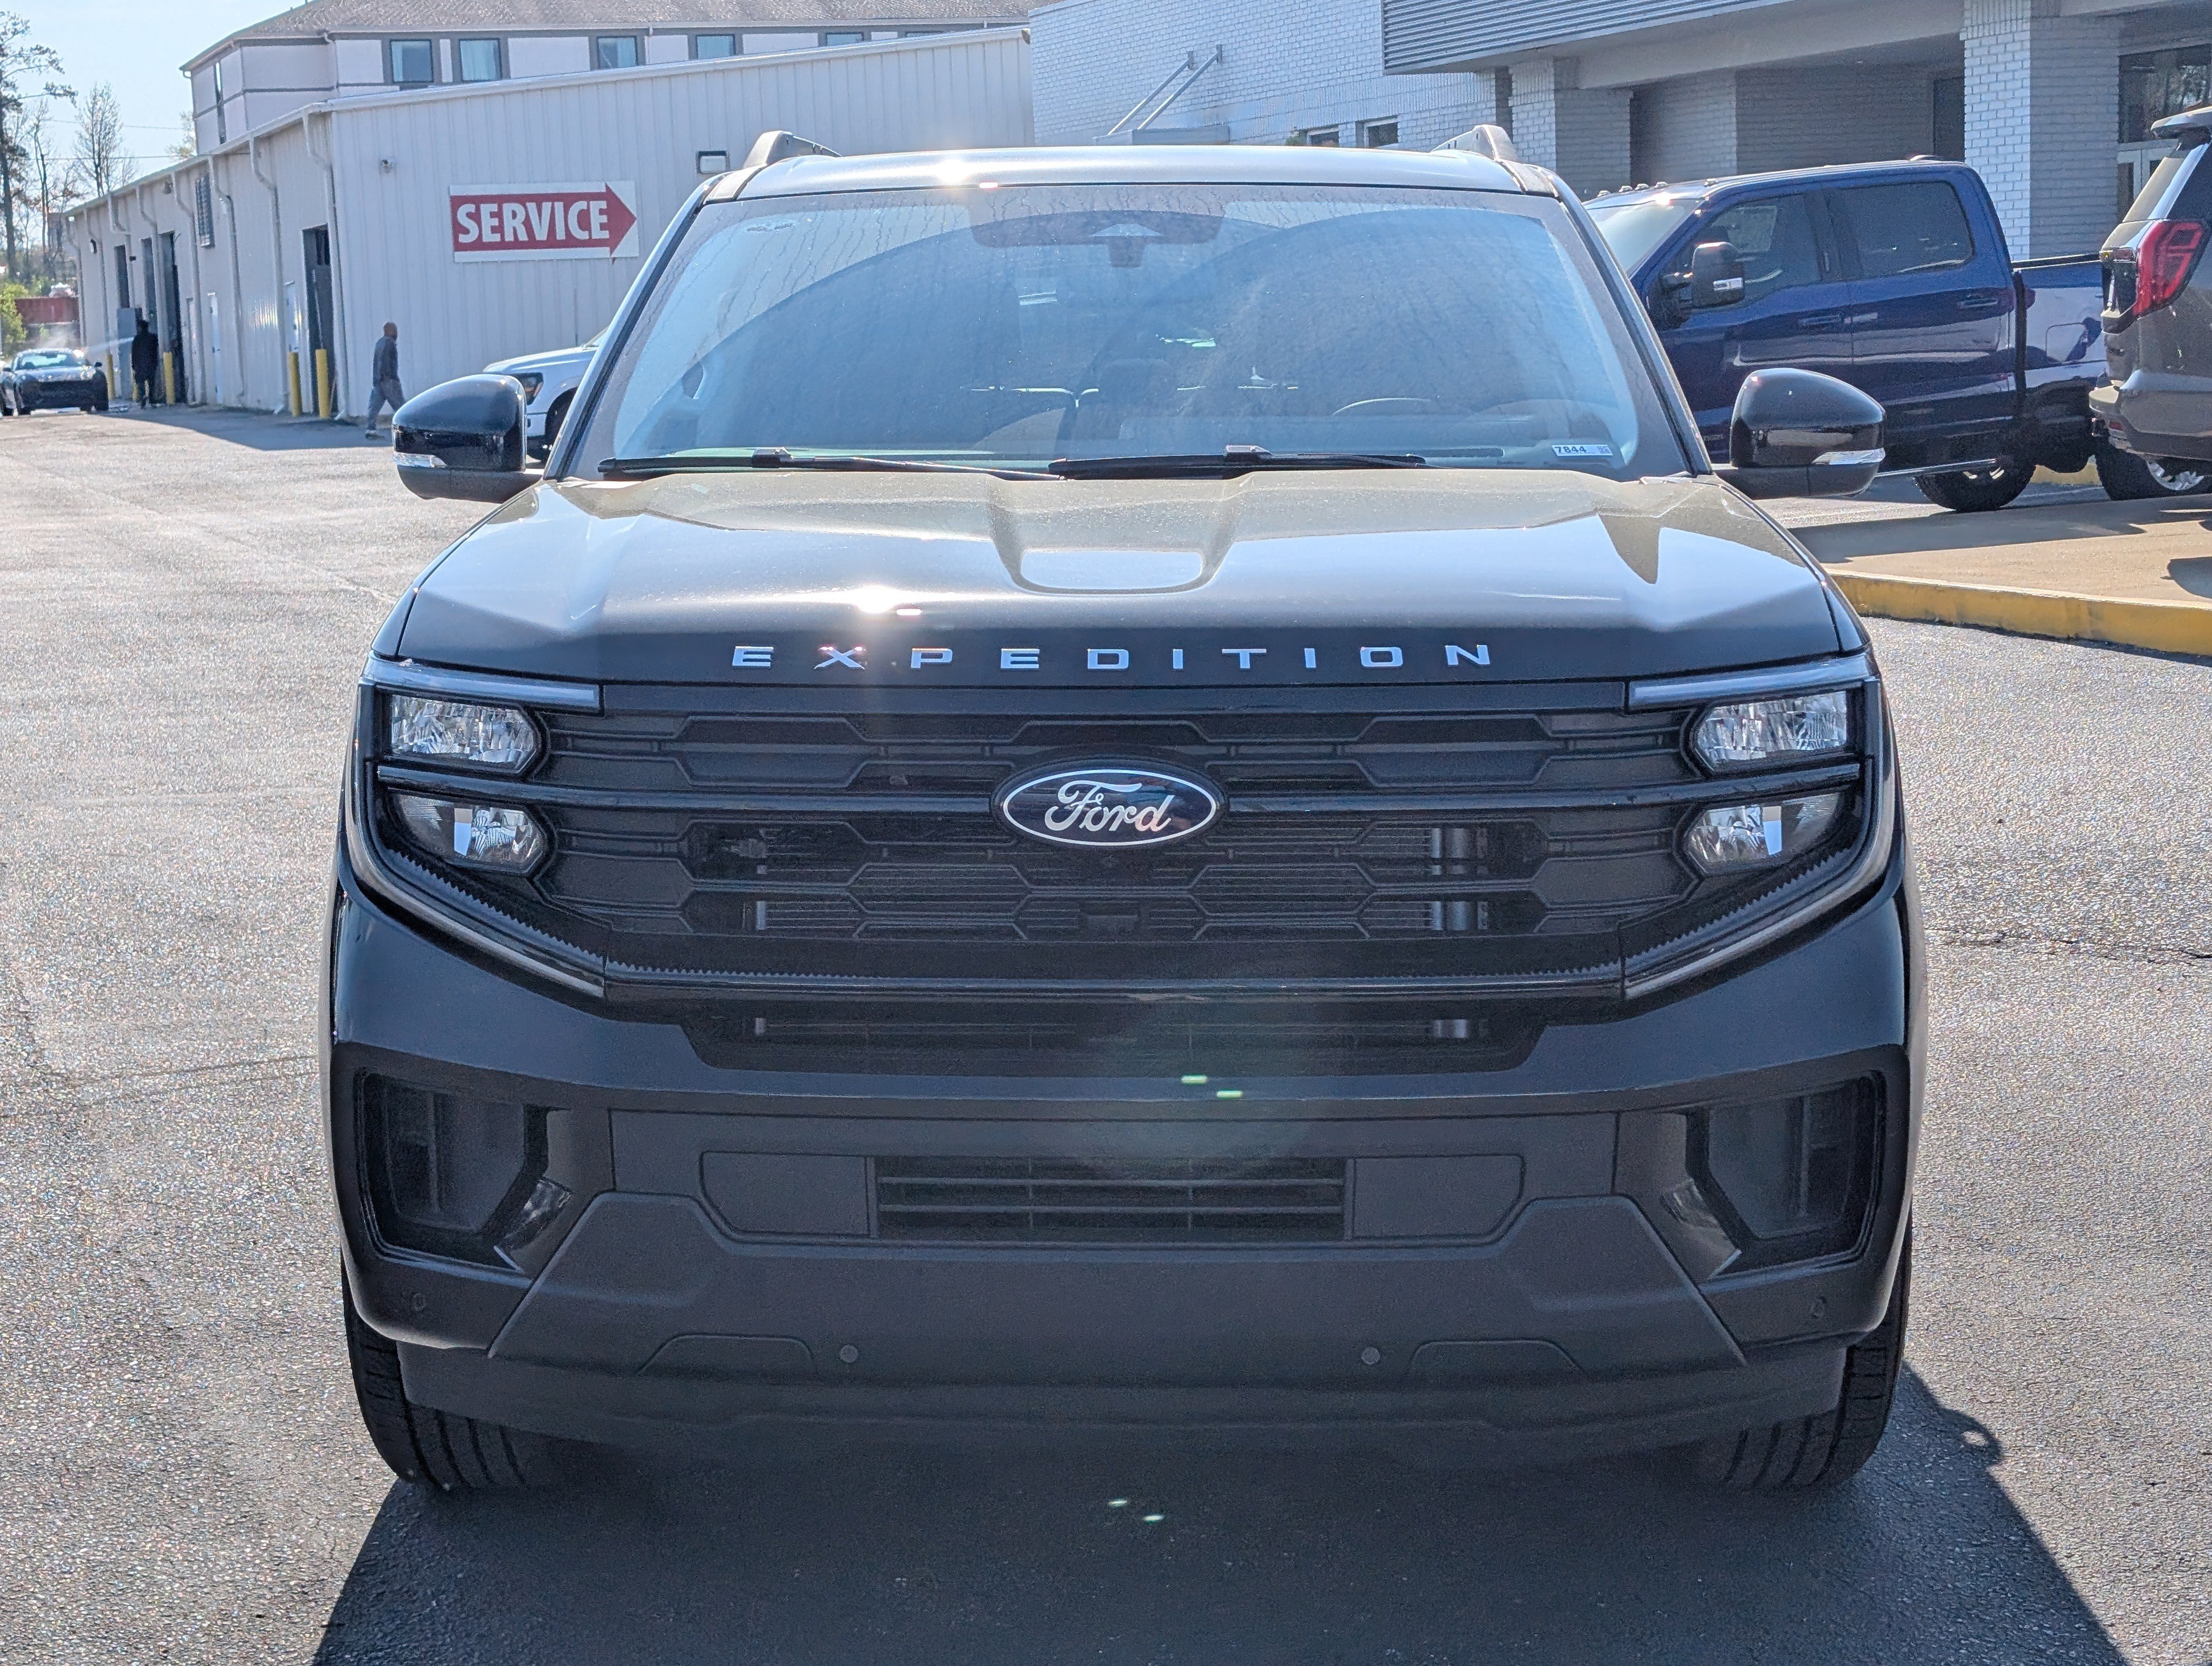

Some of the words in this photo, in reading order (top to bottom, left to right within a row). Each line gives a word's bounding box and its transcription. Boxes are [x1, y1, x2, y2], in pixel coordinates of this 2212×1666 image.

[457, 200, 610, 243] SERVICE
[732, 644, 1490, 670] EXPEDITION
[1044, 780, 1174, 831] Ford
